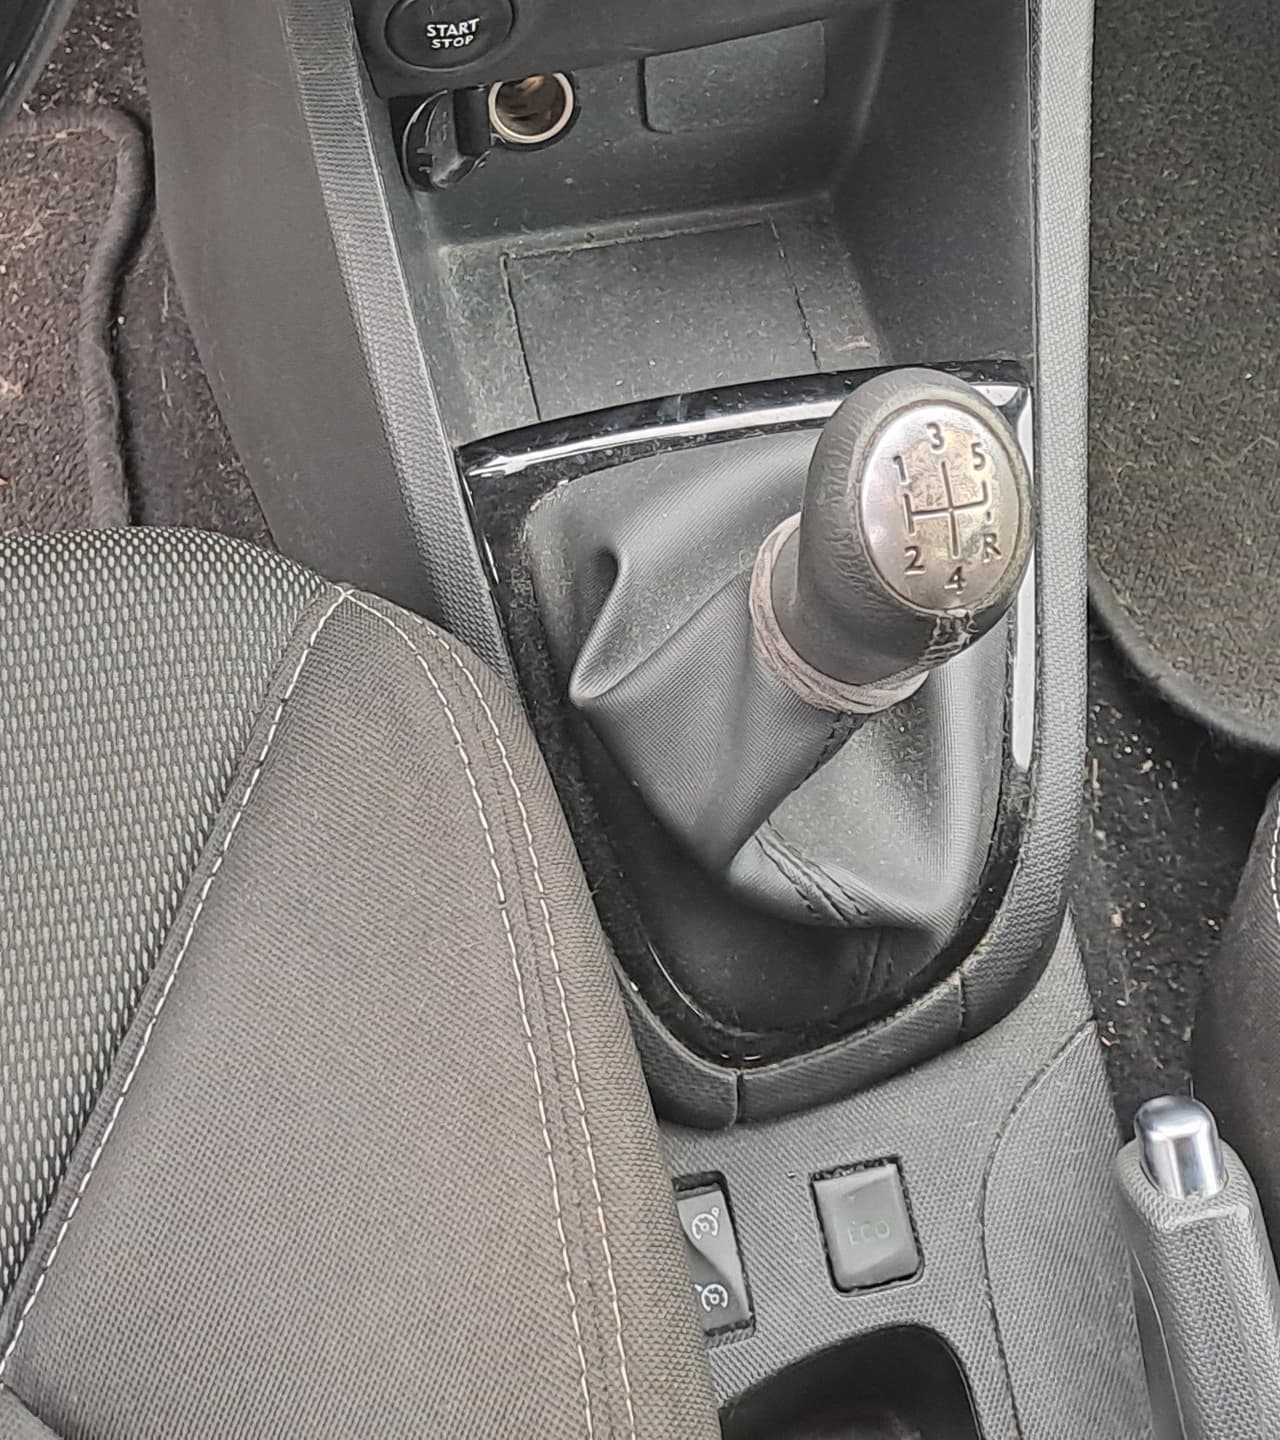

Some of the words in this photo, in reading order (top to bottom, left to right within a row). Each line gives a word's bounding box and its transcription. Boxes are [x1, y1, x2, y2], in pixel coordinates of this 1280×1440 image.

[426, 17, 480, 38] START
[431, 34, 474, 49] STOP
[926, 422, 945, 454] 3
[893, 454, 910, 485] 1
[970, 441, 988, 472] 5
[904, 545, 926, 576] 2
[982, 532, 1002, 564] R
[944, 565, 967, 595] 4
